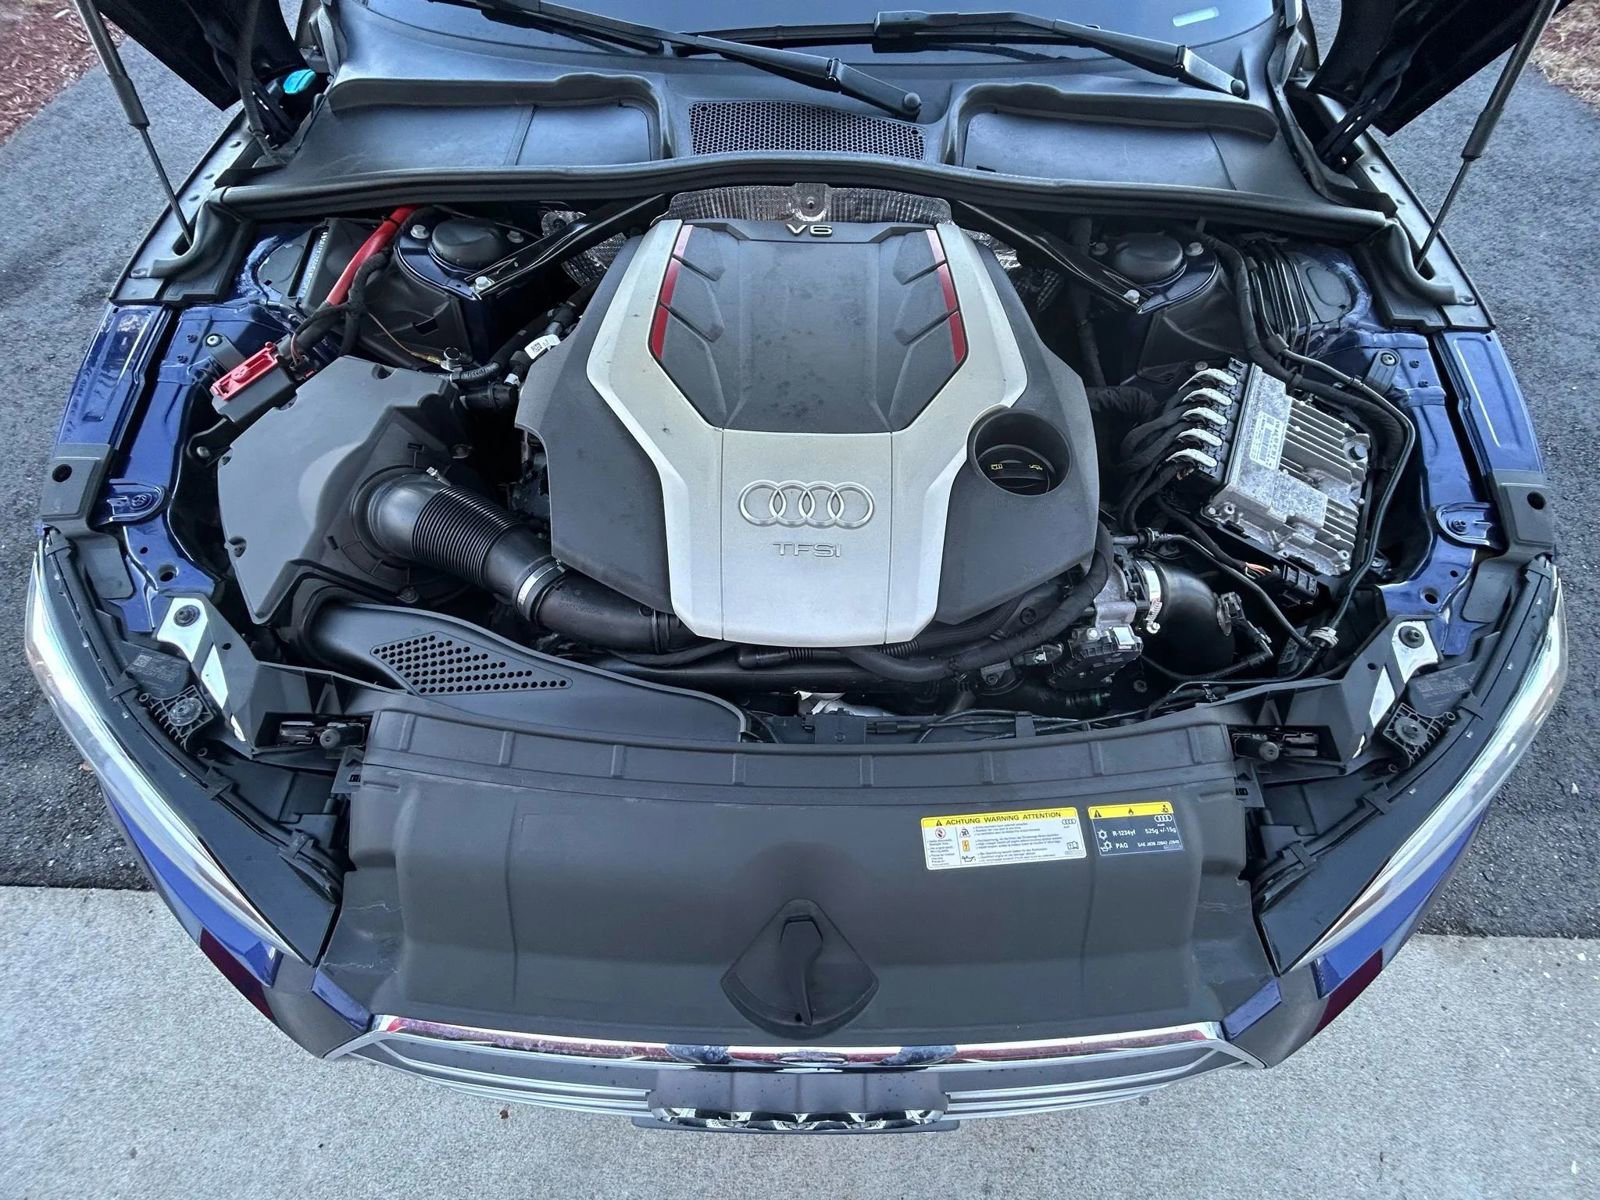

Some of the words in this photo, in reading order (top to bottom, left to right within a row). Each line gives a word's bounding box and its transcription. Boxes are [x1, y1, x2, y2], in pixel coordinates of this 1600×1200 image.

[786, 223, 833, 237] V6
[773, 542, 842, 557] TFSI
[945, 818, 980, 826] ACHTUNG
[984, 815, 1019, 823] WARNING
[1022, 811, 1061, 820] ATTENTION
